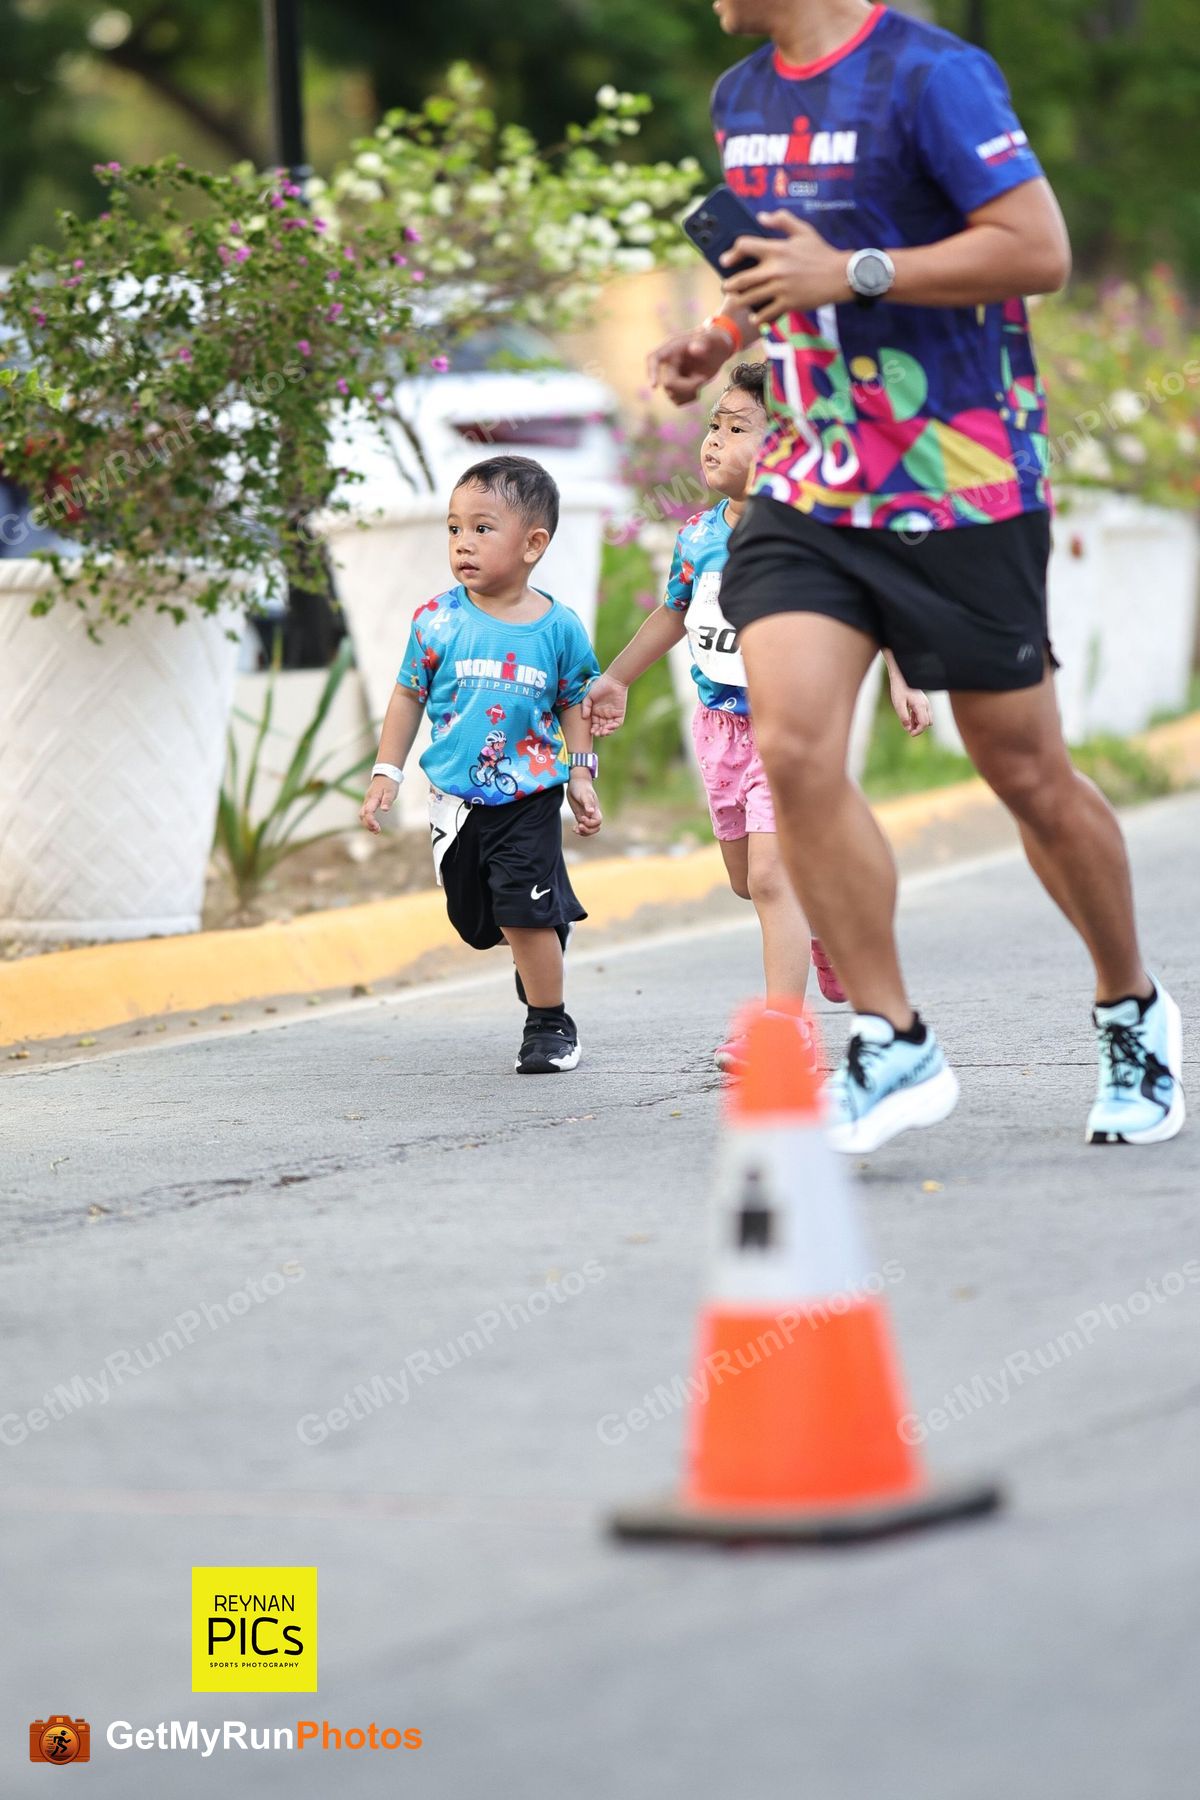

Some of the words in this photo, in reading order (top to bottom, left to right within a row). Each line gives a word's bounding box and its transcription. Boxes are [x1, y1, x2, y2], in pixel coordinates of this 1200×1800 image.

[723, 115, 857, 168] IRONMAN
[698, 625, 743, 654] 30
[455, 652, 547, 687] IRONKIDS
[457, 678, 542, 699] HILIPPINS
